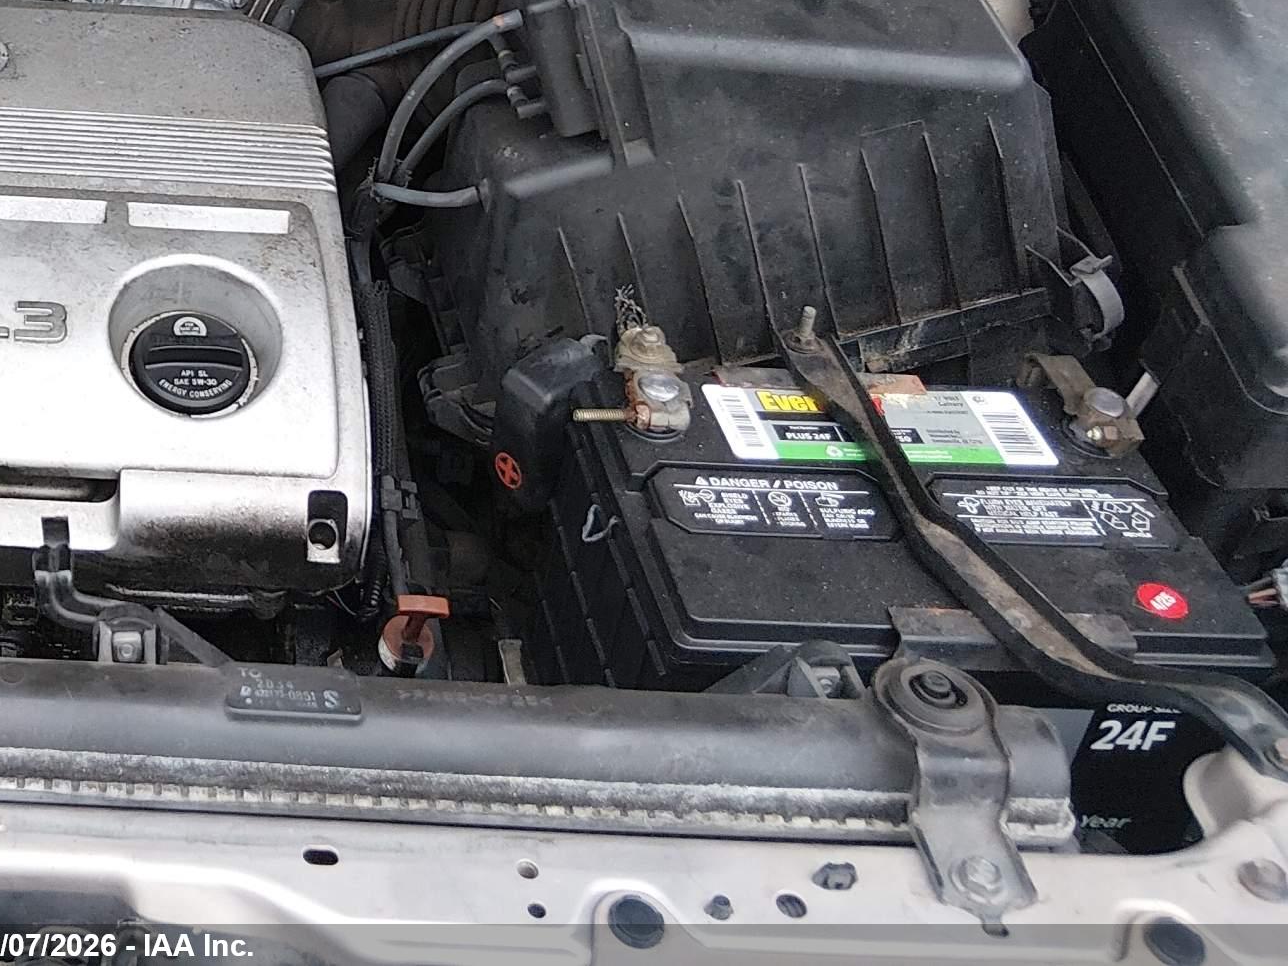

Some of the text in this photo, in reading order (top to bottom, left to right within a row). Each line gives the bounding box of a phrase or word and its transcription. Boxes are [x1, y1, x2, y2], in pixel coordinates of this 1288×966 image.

[180, 369, 194, 377] API
[158, 378, 233, 398] ENERGY CONSERVING
[173, 378, 218, 386] SAE 5W-30
[755, 390, 822, 411] Ever
[785, 432, 812, 440] PLUS
[708, 477, 771, 489] DANGER
[783, 480, 839, 490] POISON
[1091, 719, 1176, 751] 24F
[1079, 814, 1132, 829] Year
